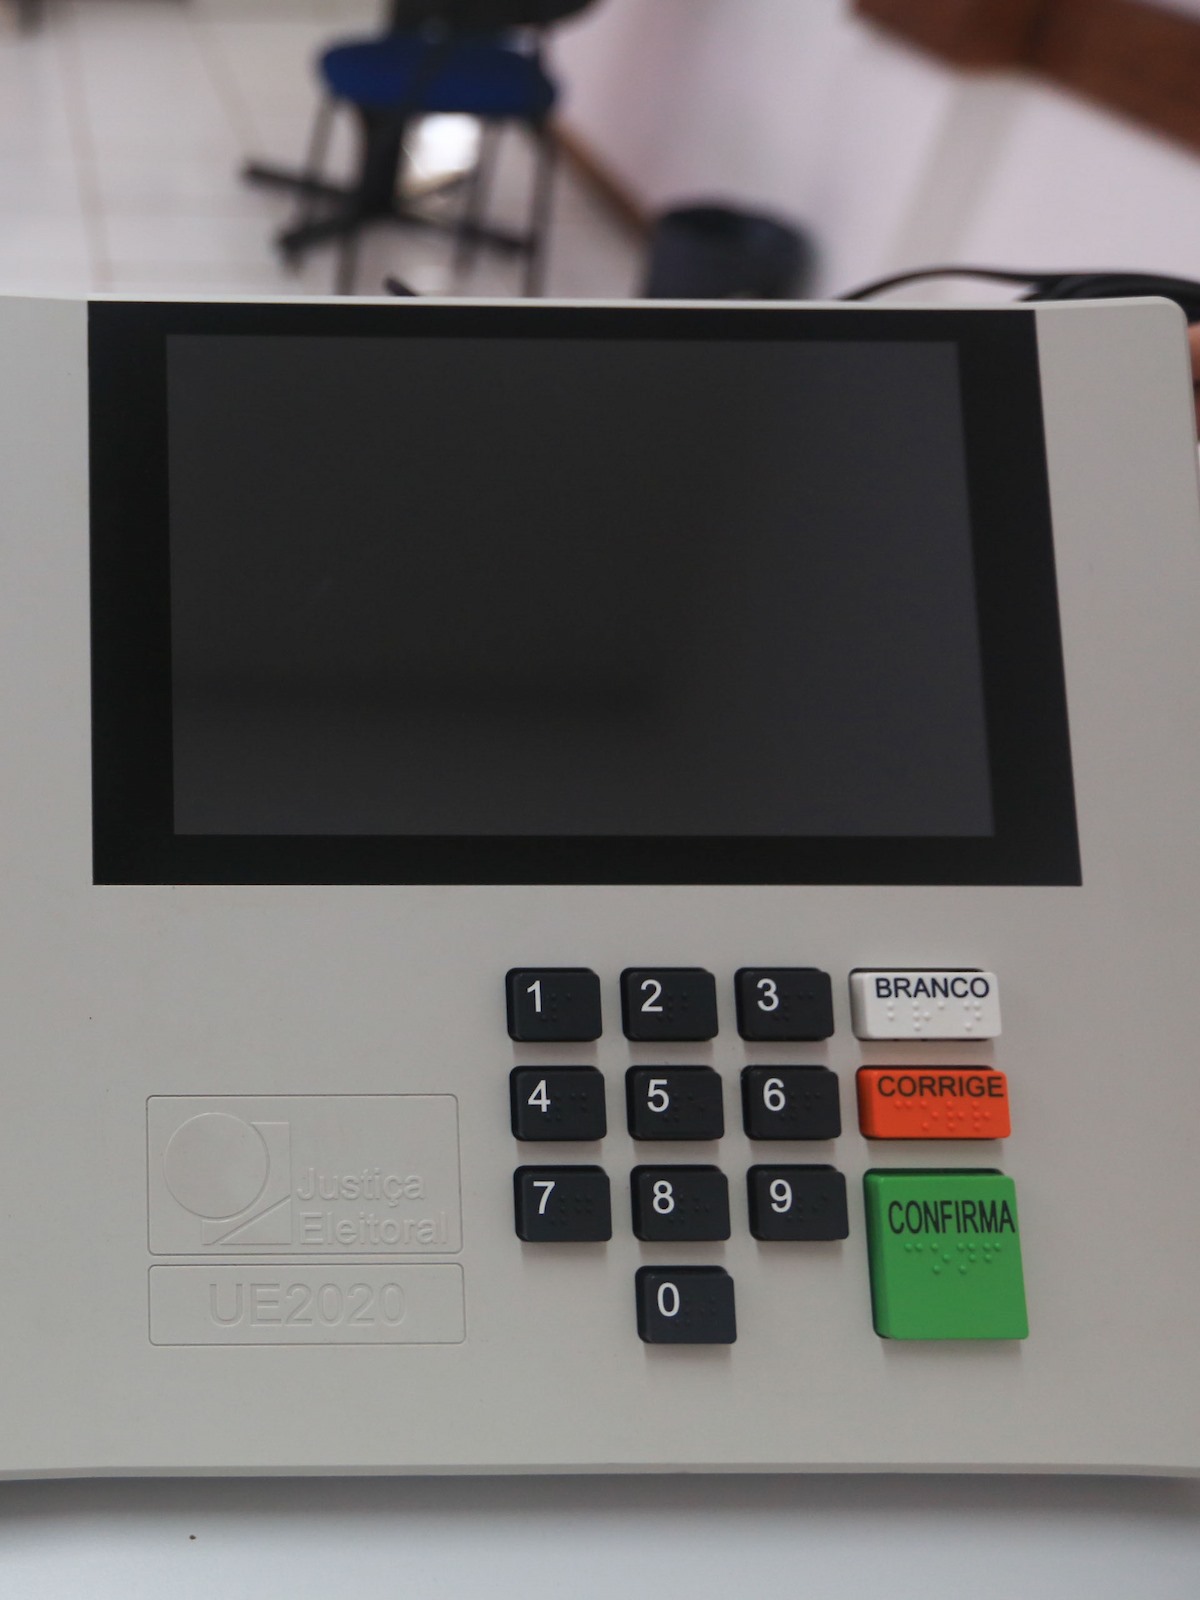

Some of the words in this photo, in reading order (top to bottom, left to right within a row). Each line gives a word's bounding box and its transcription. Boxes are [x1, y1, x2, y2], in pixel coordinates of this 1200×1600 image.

[527, 980, 542, 1013] 1
[640, 979, 663, 1012] 2
[756, 978, 779, 1012] 3
[875, 976, 990, 999] BRANCO
[527, 1079, 551, 1113] 4
[647, 1079, 670, 1113] 5
[763, 1077, 786, 1112] 6
[877, 1075, 1005, 1098] CORRIGE
[297, 1168, 425, 1207] Justiça
[533, 1180, 556, 1215] 7
[652, 1180, 675, 1215] 8
[769, 1178, 793, 1213] 9
[300, 1212, 448, 1245] Eleitoral
[888, 1199, 1016, 1235] CONFIRMA
[209, 1282, 407, 1327] UE2020
[657, 1282, 680, 1317] 0
